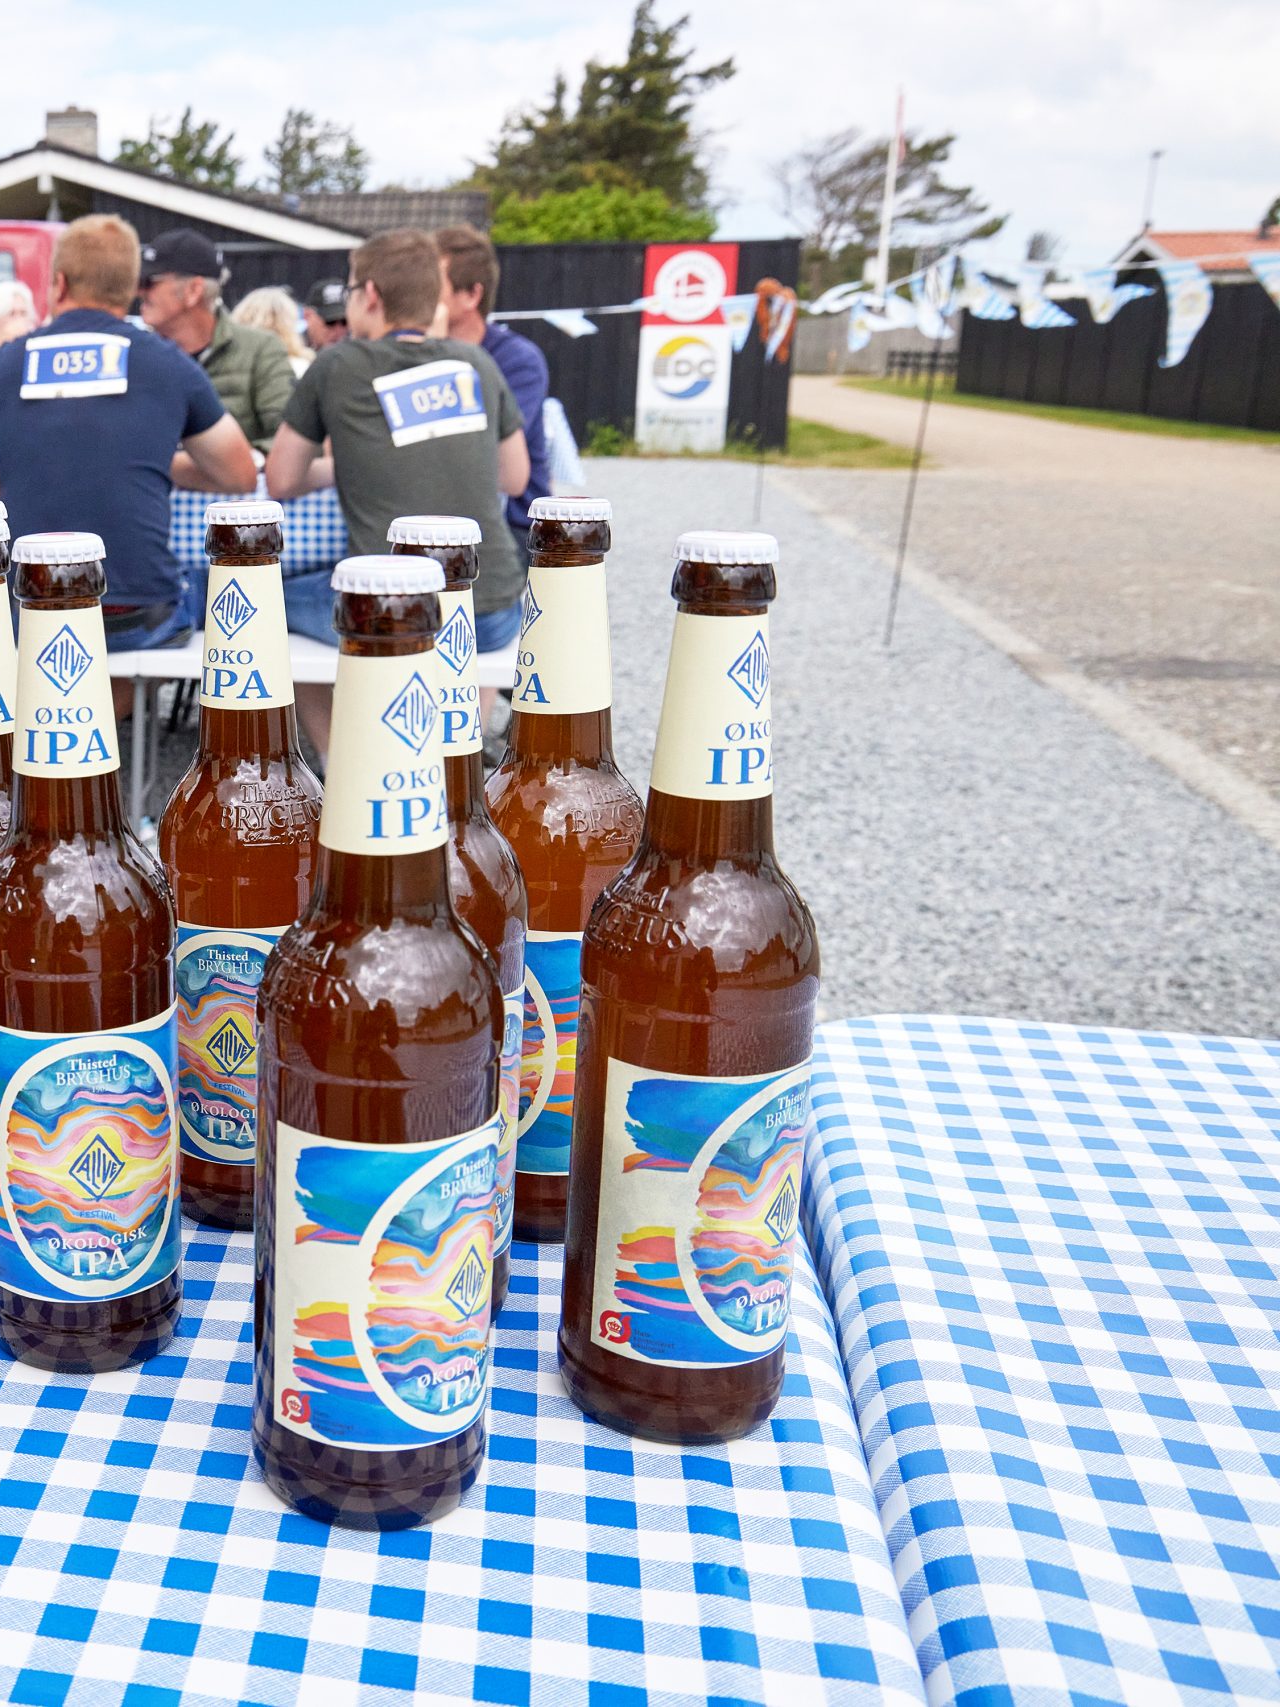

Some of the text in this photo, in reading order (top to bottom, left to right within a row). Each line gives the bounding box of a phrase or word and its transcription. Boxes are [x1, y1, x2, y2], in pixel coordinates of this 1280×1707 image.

[52, 349, 98, 375] 035
[411, 382, 458, 414] 036
[208, 647, 254, 665] ØKO
[201, 666, 273, 699] IPA
[35, 705, 93, 725] ØKO
[725, 718, 771, 742] ØKO
[24, 727, 112, 765] IPA
[382, 764, 442, 794] ØKO
[198, 958, 262, 975] BRYGHUS
[207, 948, 249, 962] Thisted
[67, 1055, 117, 1071] Thisted
[56, 1065, 131, 1087] BRYGHUS
[214, 1082, 247, 1098] FESTIVAL
[191, 1100, 256, 1121] ØKOLOGI
[207, 1116, 256, 1142] IPA
[453, 1149, 490, 1180] Thisted
[79, 1209, 118, 1222] FESTIVAL
[48, 1225, 148, 1251] ØKOLOGISK
[70, 1250, 130, 1277] IPA
[438, 1366, 482, 1413] IPA
